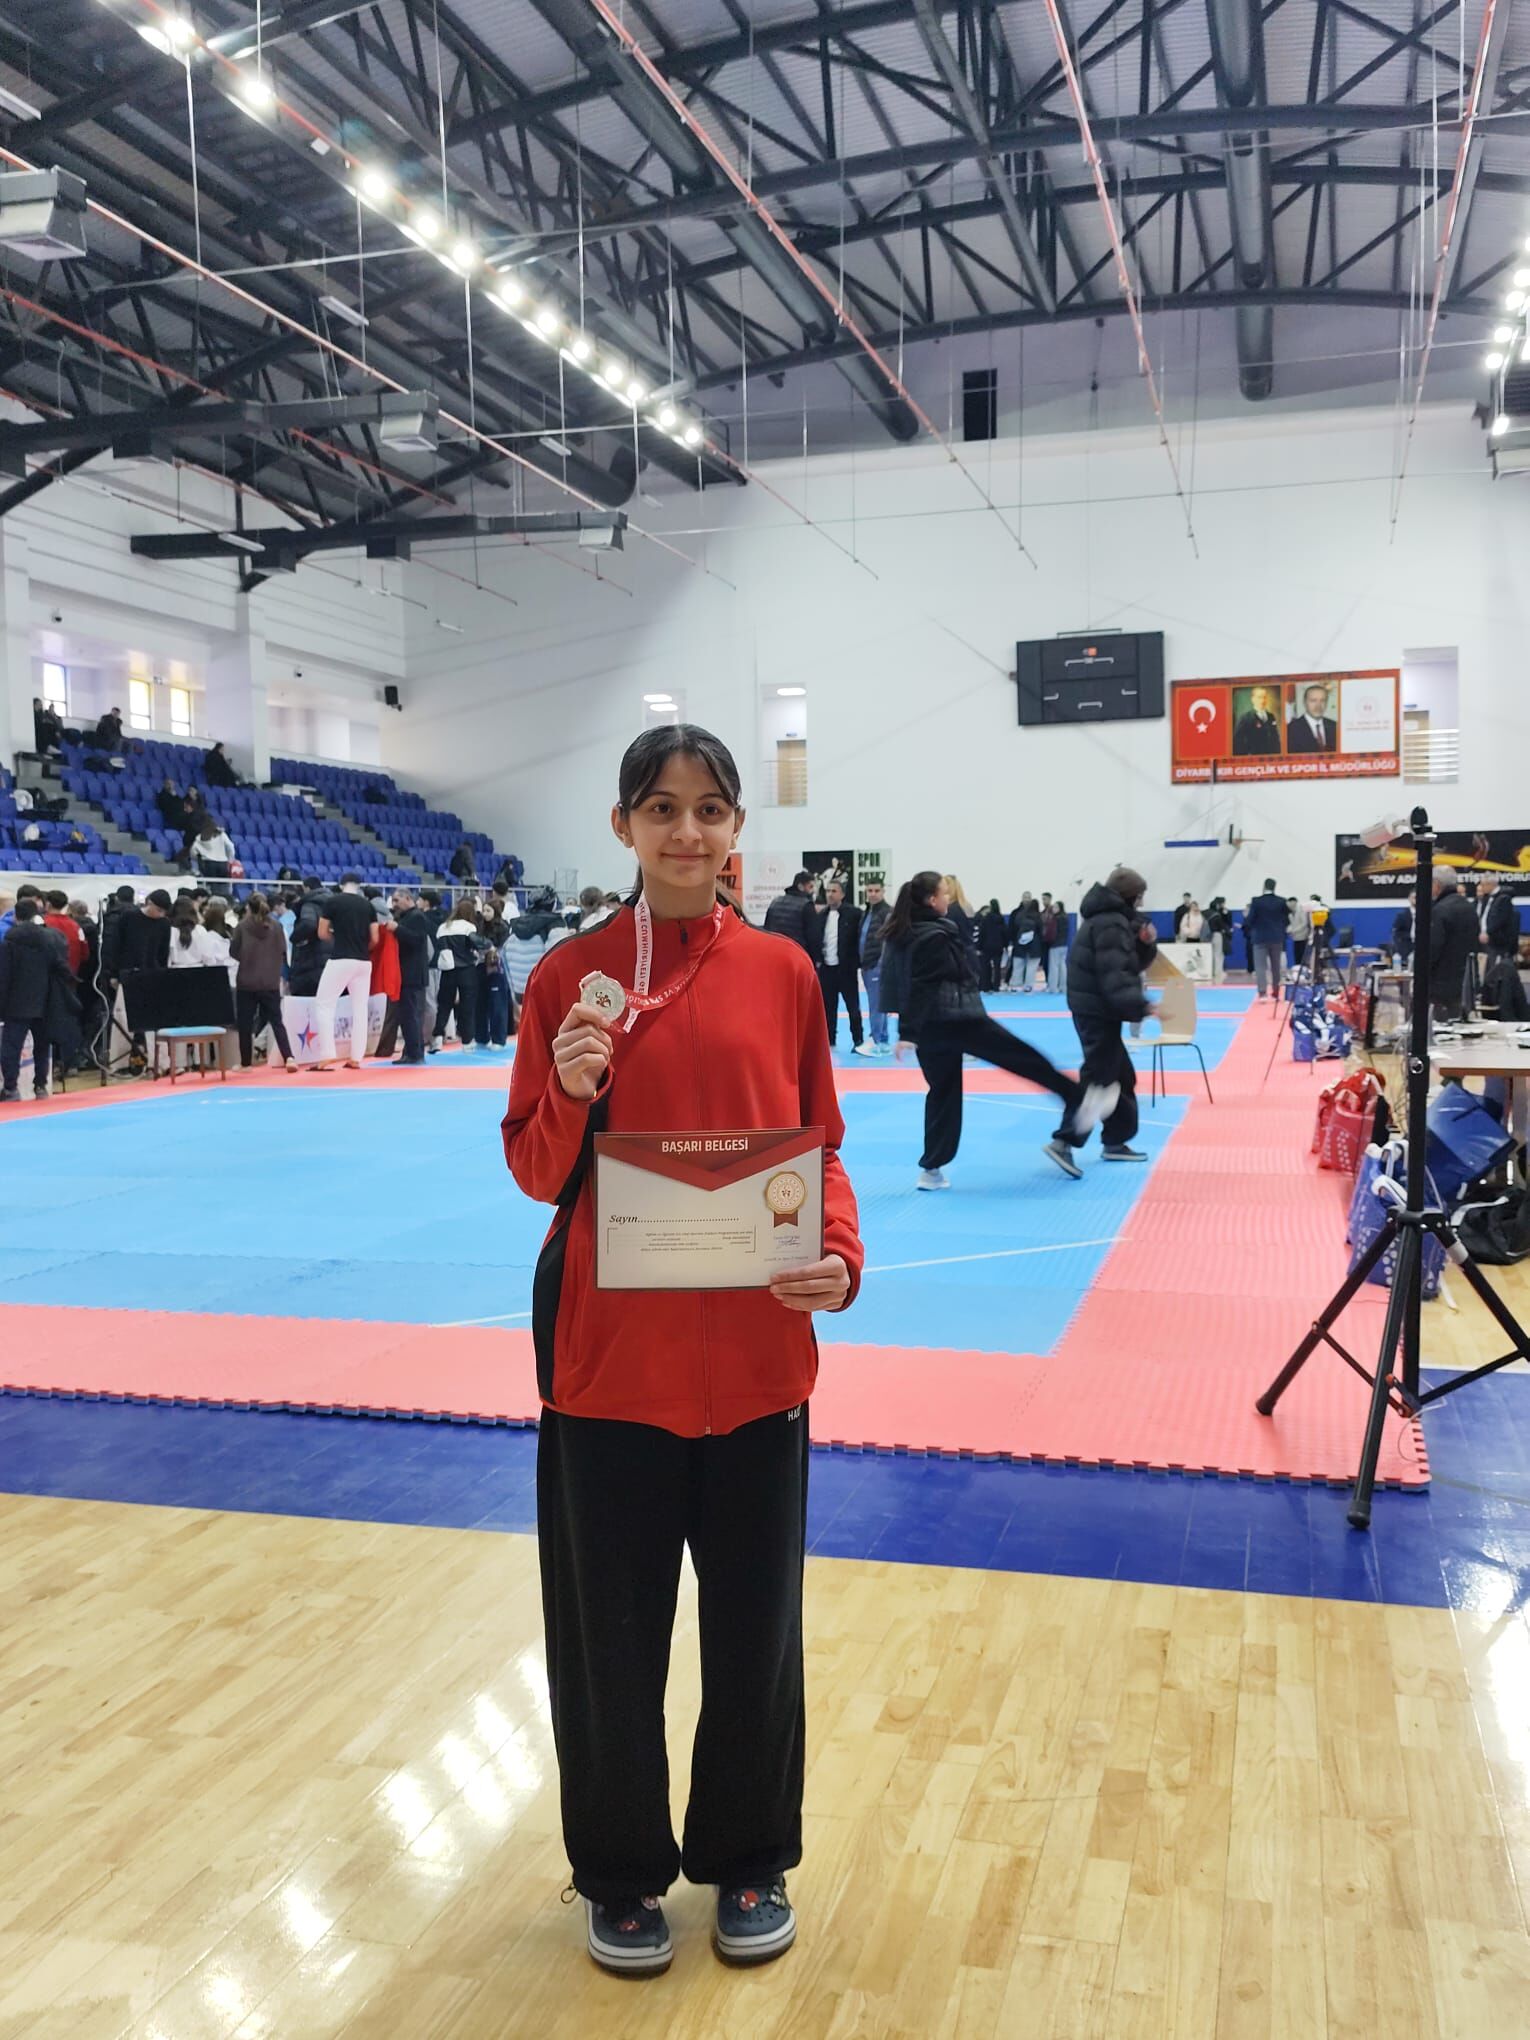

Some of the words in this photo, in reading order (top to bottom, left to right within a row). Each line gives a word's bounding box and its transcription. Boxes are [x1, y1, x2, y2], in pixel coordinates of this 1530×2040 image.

[1176, 767, 1233, 778] DİYARBKIR
[1235, 764, 1276, 777] GENÇLİK
[1277, 763, 1291, 774] VE
[1292, 763, 1318, 773] SPOR
[1319, 760, 1328, 772] İL
[1329, 758, 1396, 772] MÜDÜRLÜĞÜ
[661, 1140, 702, 1155] BAŞARI
[704, 1136, 749, 1152] BELGESİ
